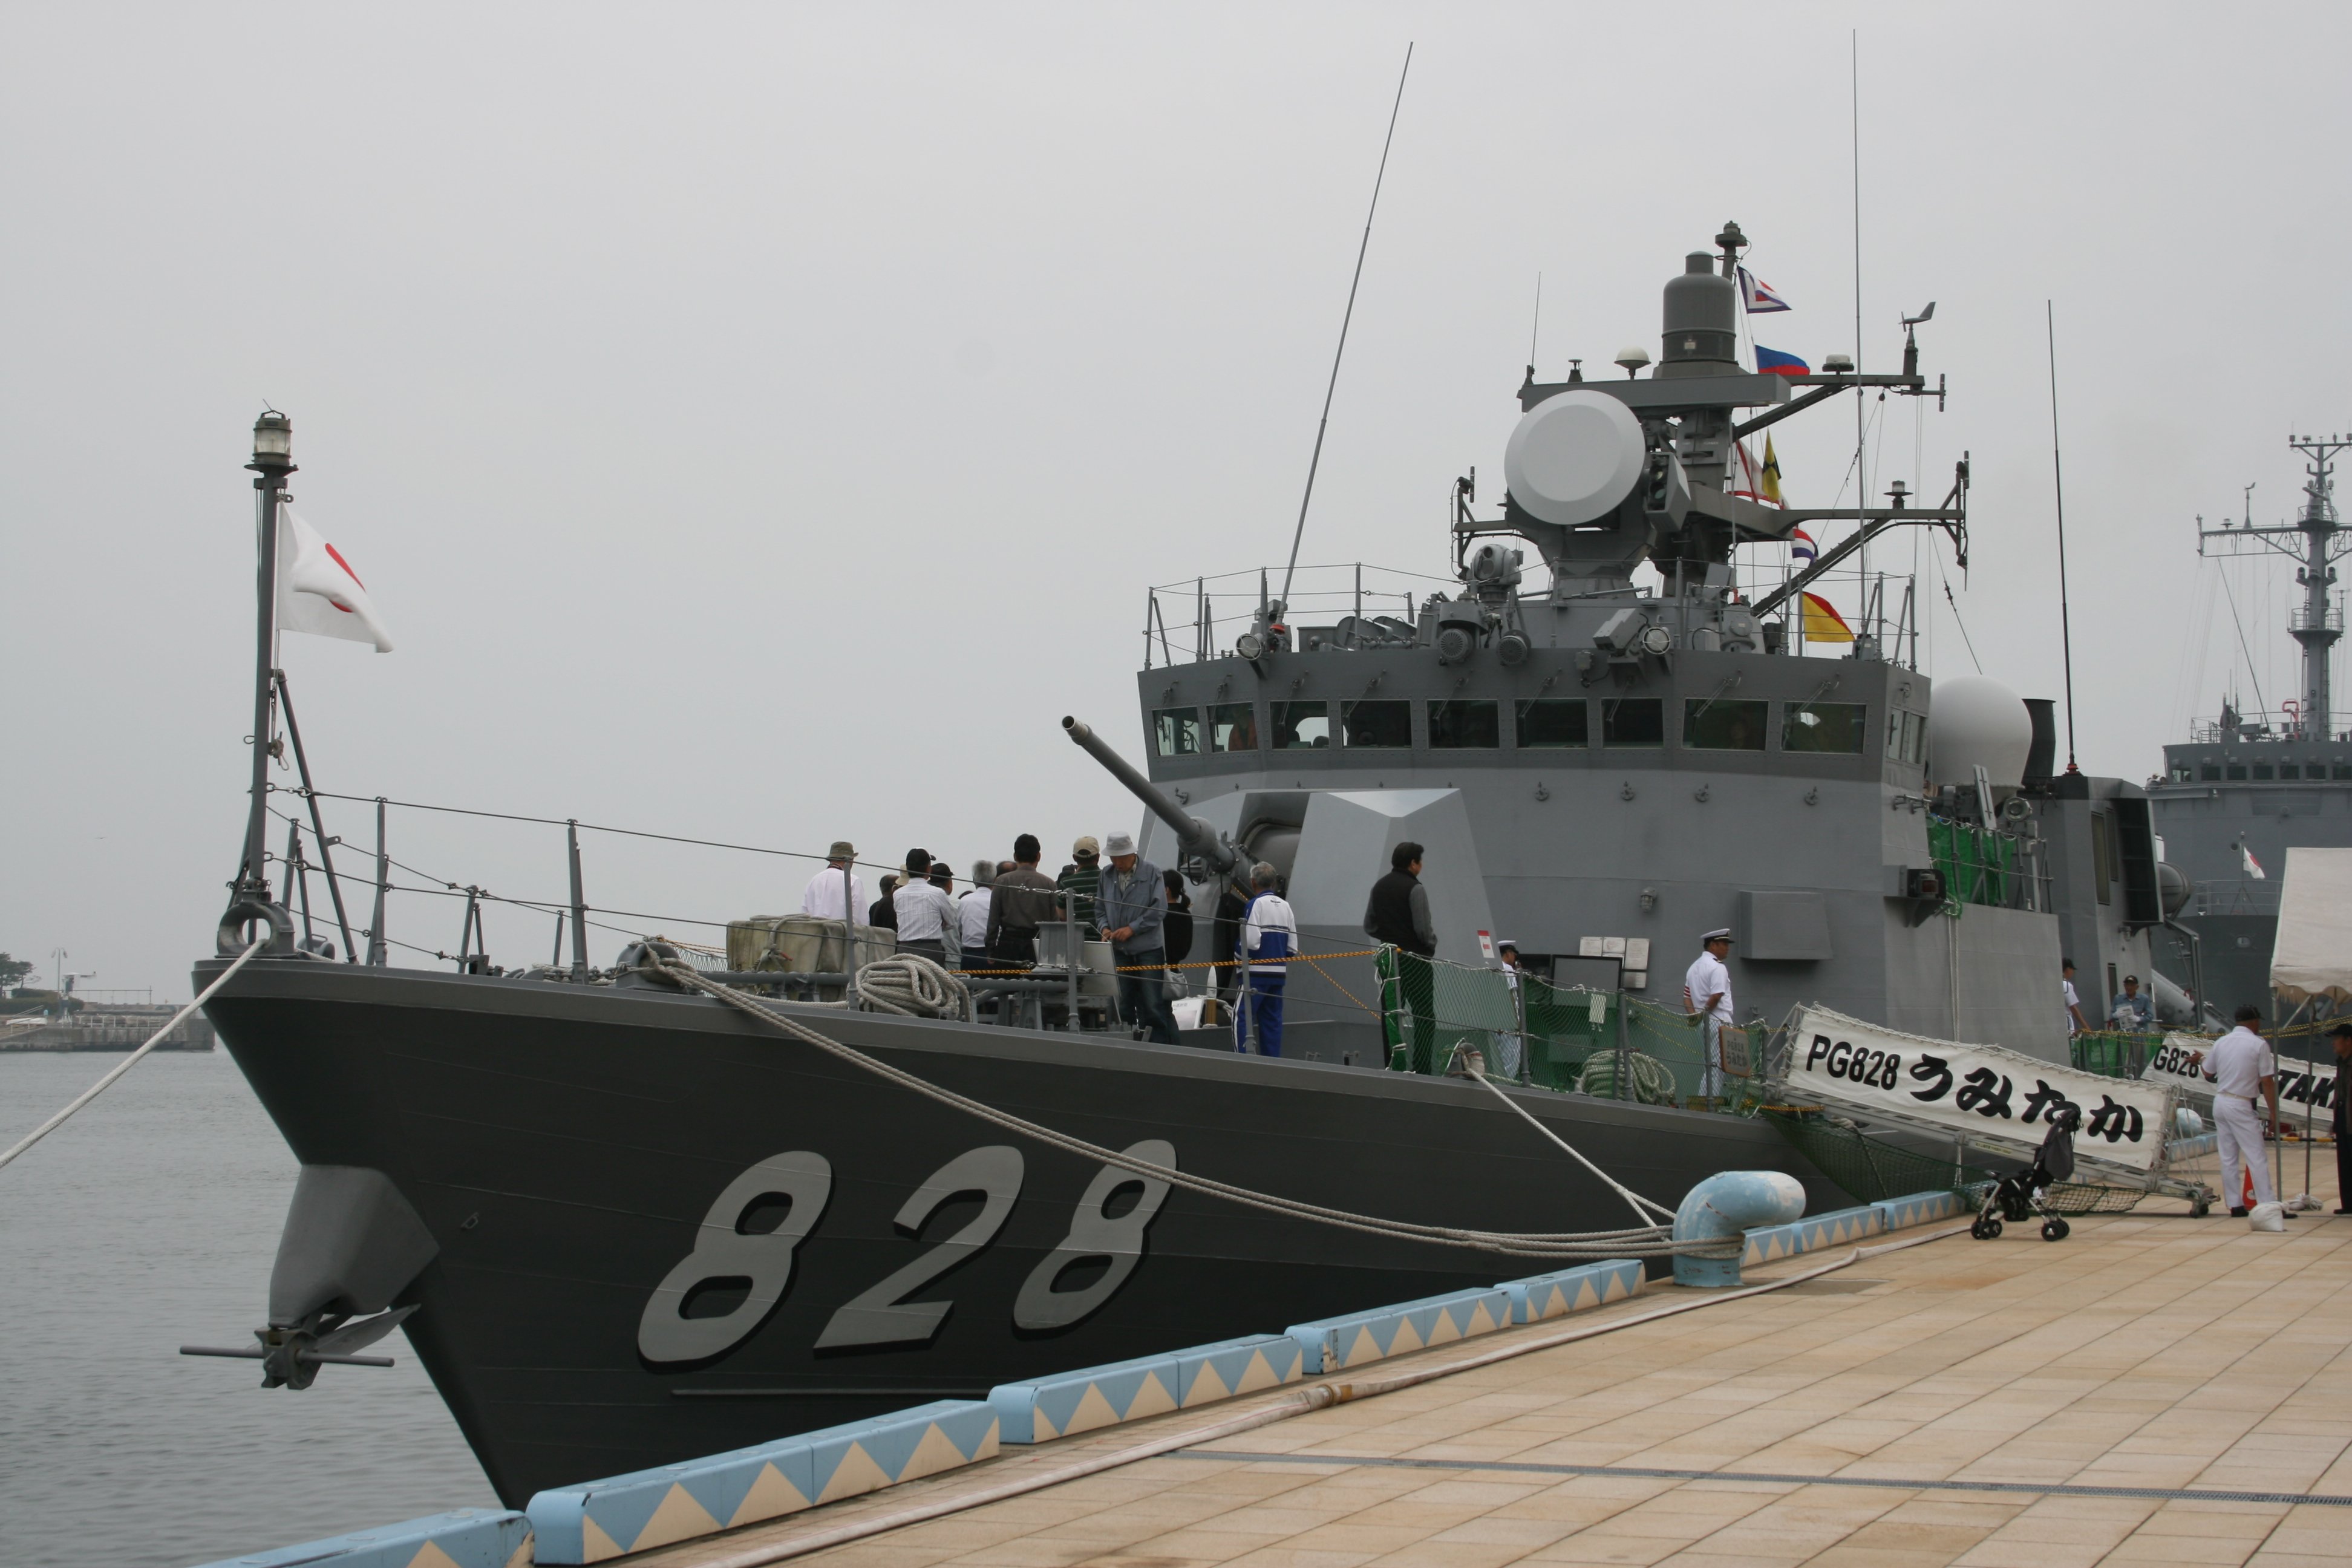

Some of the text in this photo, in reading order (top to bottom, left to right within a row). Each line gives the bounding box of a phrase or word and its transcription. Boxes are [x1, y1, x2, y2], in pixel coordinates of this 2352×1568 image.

[1806, 1034, 2143, 1143] PG828 うみたか
[638, 1139, 1177, 1364] 828
